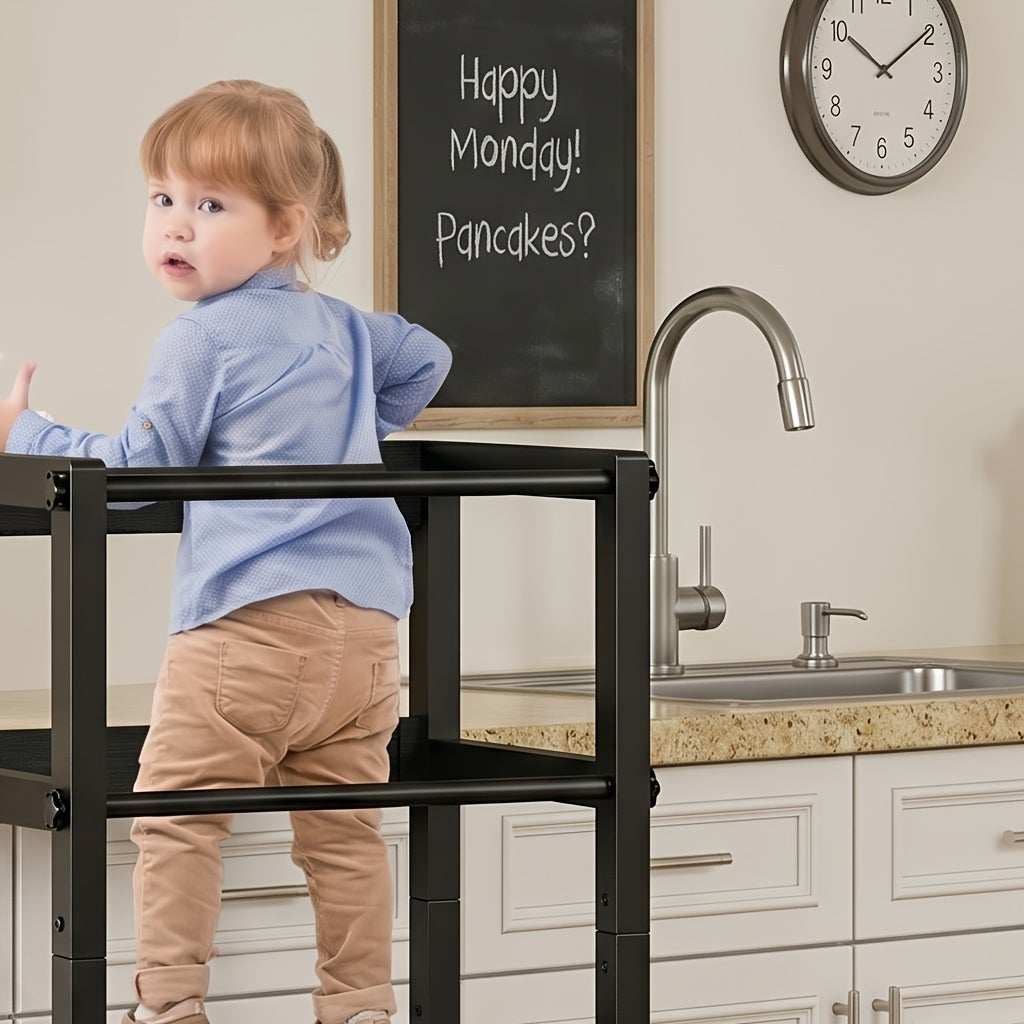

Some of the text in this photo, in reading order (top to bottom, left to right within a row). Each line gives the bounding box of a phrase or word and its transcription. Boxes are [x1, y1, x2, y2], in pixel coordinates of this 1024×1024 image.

[830, 20, 848, 42] 10
[923, 24, 935, 46] 2
[821, 57, 832, 80] 9
[933, 61, 943, 84] 3
[460, 53, 558, 124] Happy
[830, 95, 841, 117] 8
[923, 99, 934, 120] 4
[851, 125, 861, 147] 7
[903, 127, 914, 148] 5
[876, 137, 887, 159] 6
[450, 126, 582, 193] Monday!
[435, 211, 596, 269] Pancakes?
